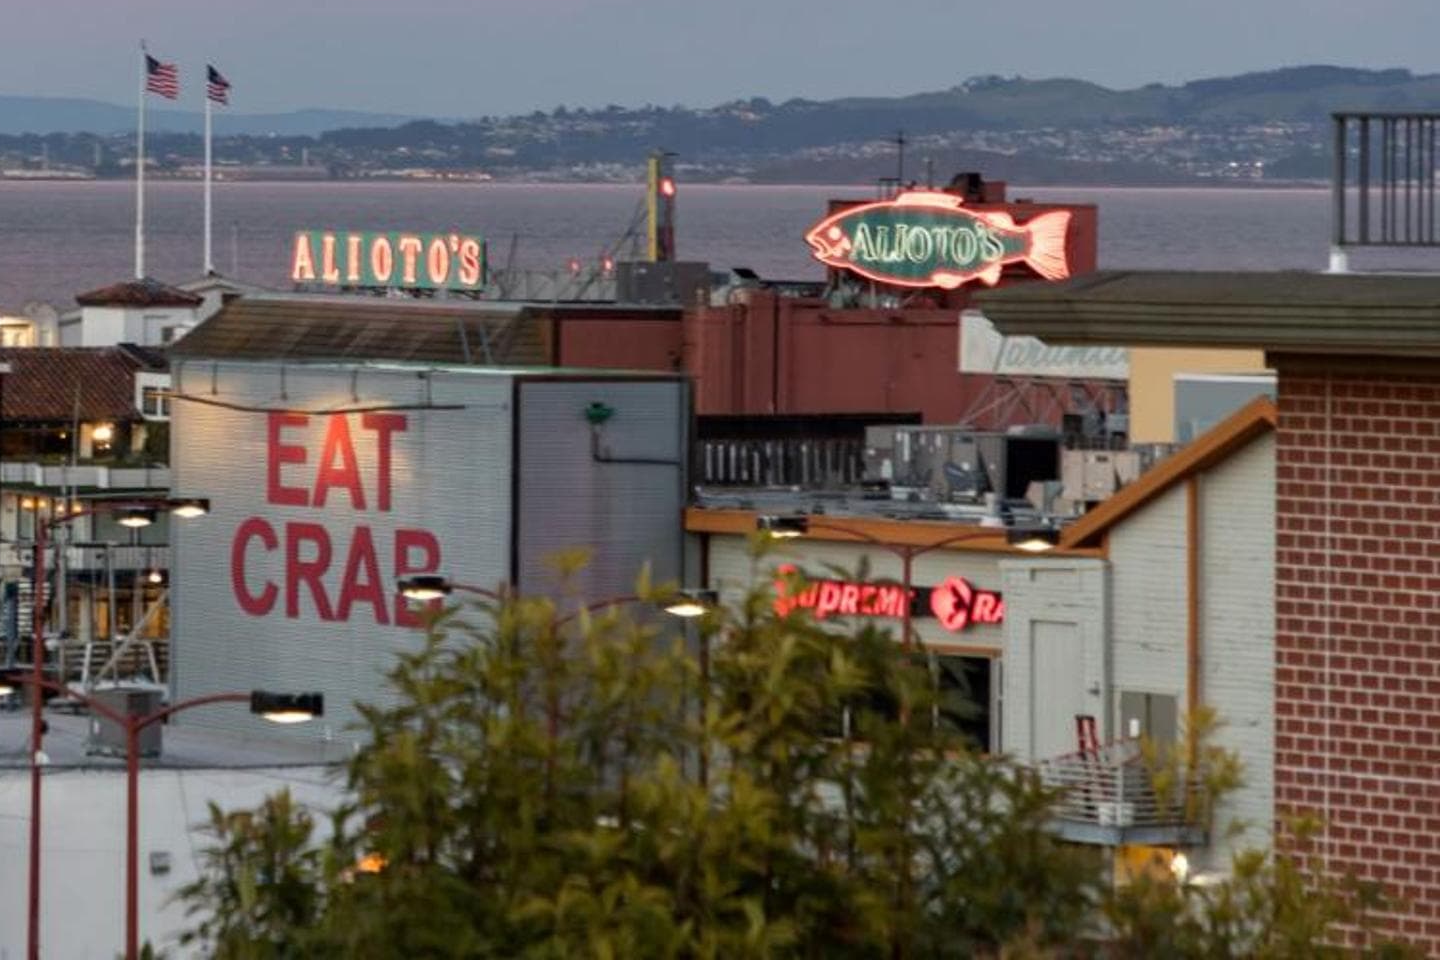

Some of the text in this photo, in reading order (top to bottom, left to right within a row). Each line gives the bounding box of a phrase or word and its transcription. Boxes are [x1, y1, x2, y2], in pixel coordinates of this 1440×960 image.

[292, 232, 481, 285] ALIOTO'S
[850, 222, 1005, 265] ALIOTO'S
[266, 411, 408, 512] EAT
[231, 516, 443, 630] CRAB
